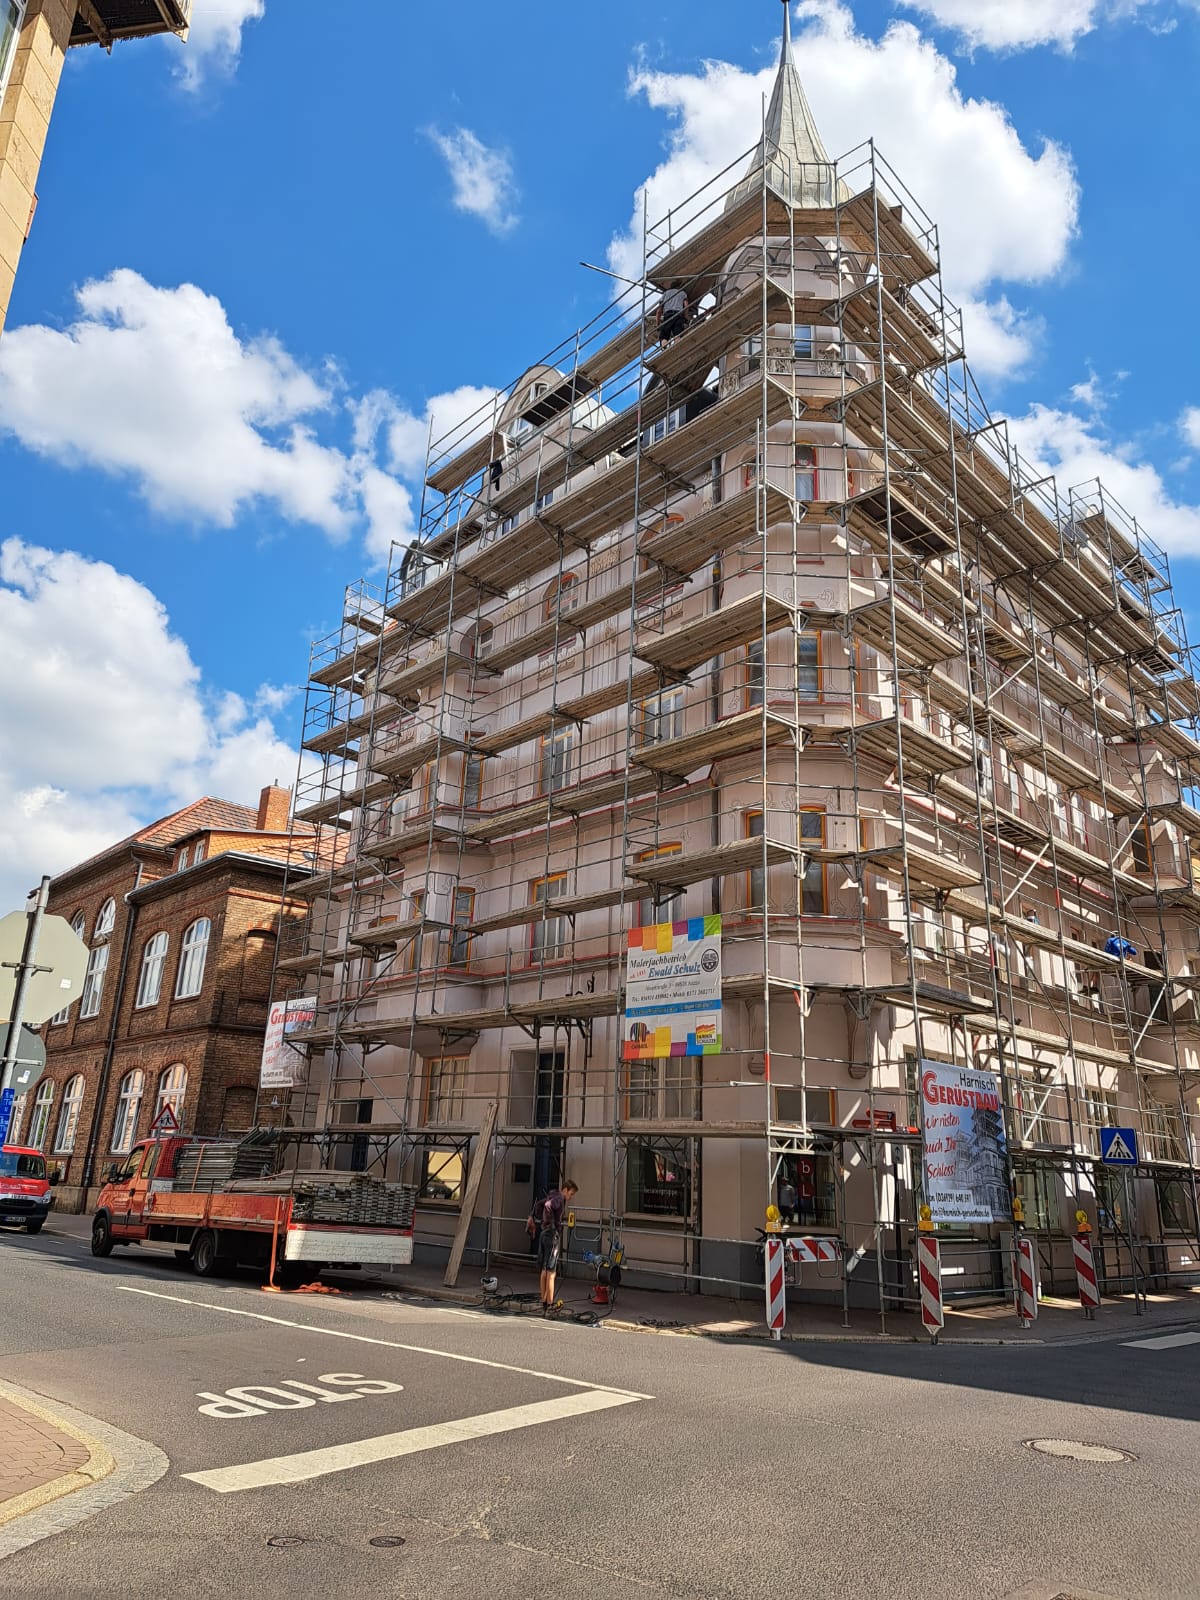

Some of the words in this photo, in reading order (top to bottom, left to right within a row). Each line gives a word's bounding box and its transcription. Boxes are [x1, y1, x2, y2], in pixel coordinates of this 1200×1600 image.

[648, 965, 673, 978] Ewald
[673, 962, 701, 975] Schulz
[959, 1072, 996, 1091] Harnisch
[195, 1372, 405, 1418] STOP
